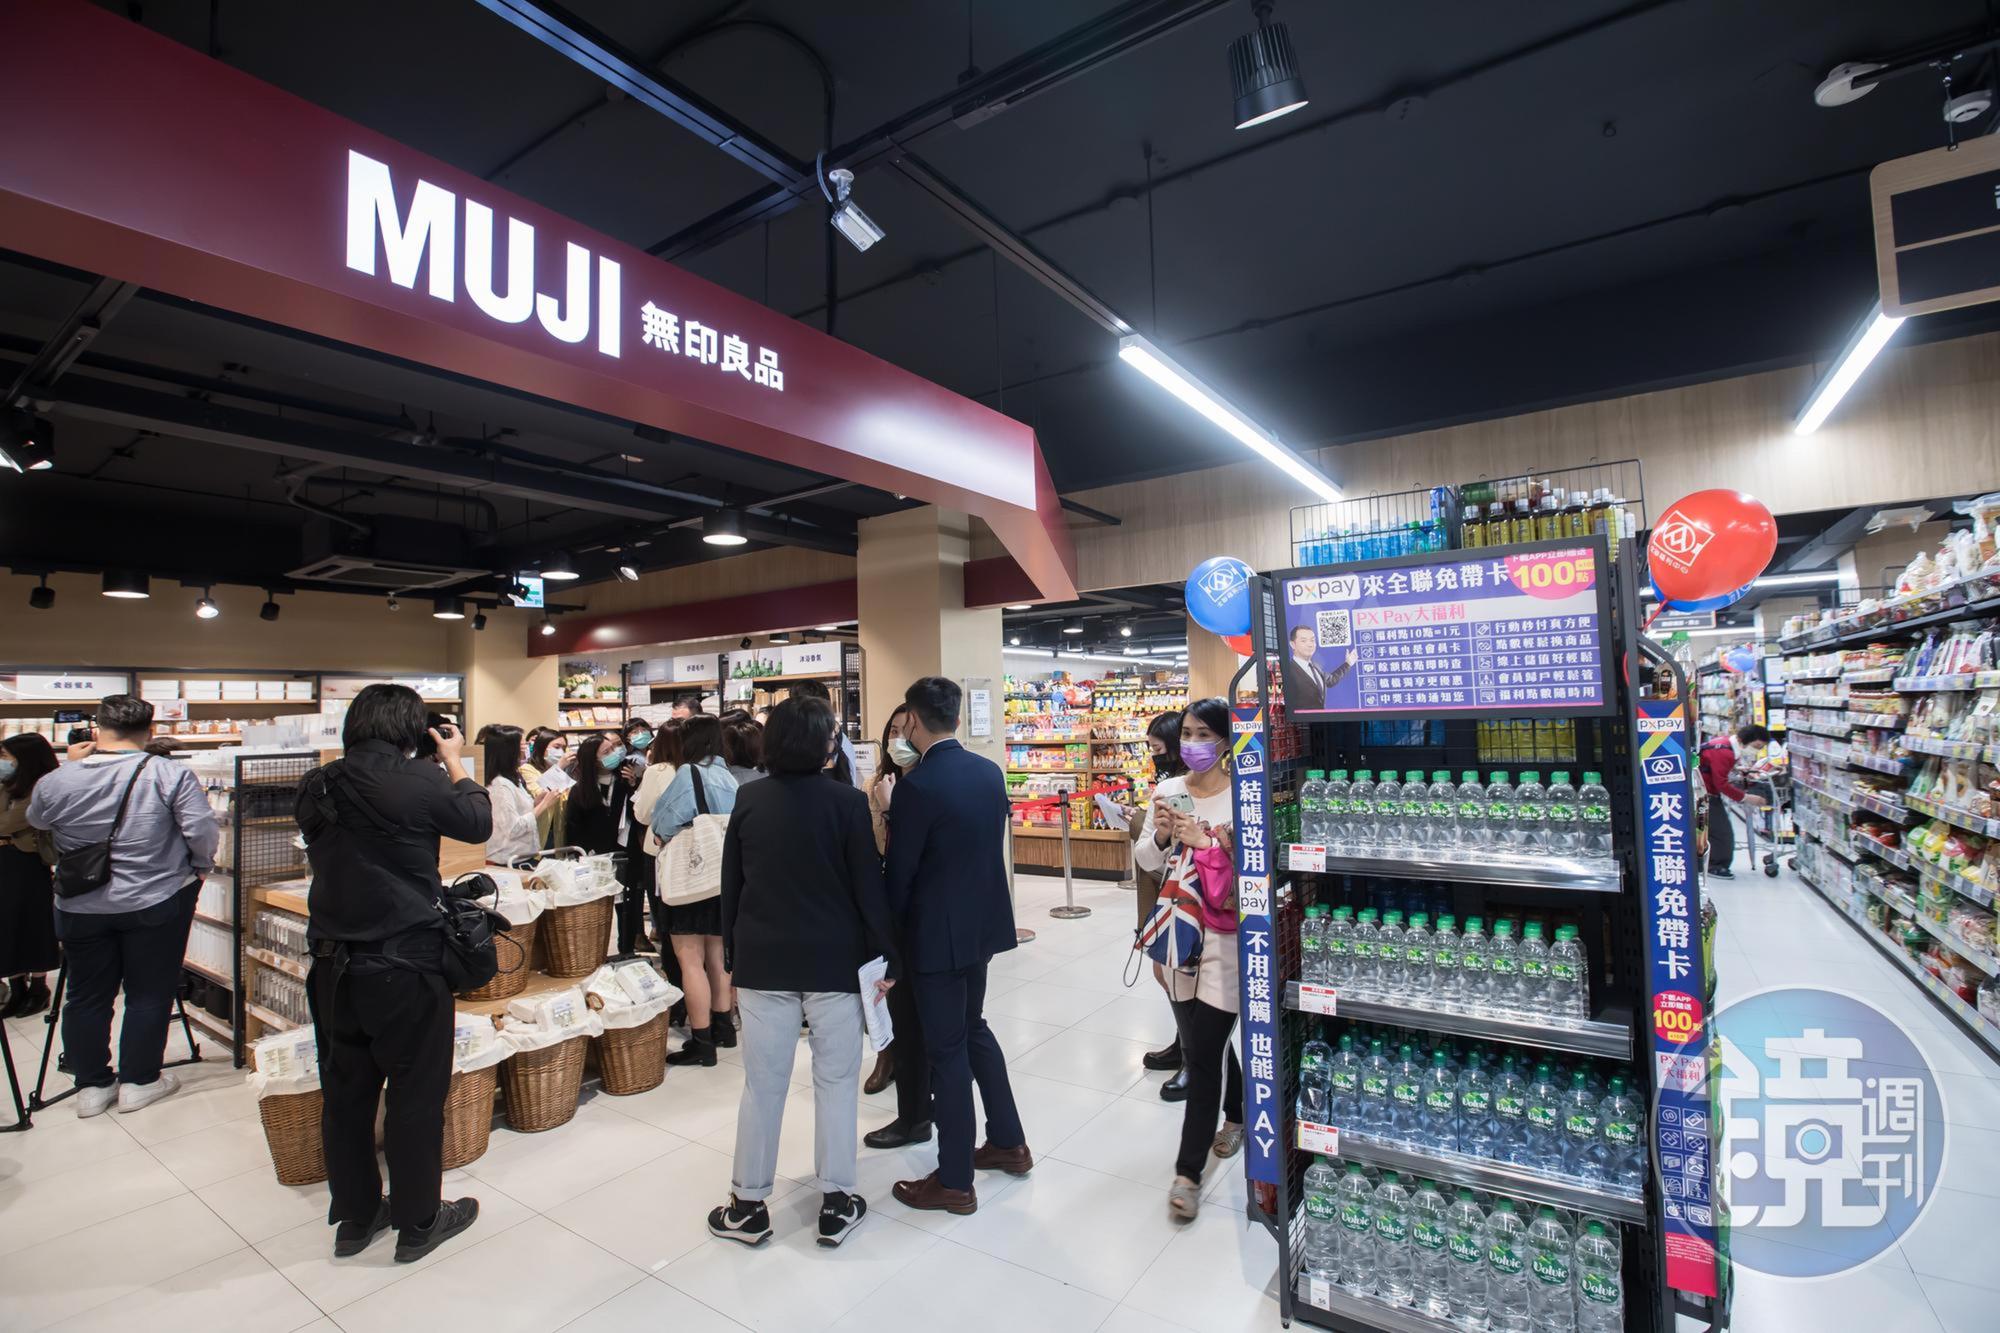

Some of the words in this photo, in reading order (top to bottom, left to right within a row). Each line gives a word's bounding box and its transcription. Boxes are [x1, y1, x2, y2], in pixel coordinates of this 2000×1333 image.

[346, 148, 621, 358] MUJI
[640, 300, 784, 392] 無印良品
[1363, 562, 1510, 597] 來全聯免帶卡
[1292, 578, 1355, 601] pxpay
[1357, 611, 1379, 625] PX
[1495, 616, 1591, 634] 行動秒付真方便
[1377, 642, 1461, 656] 手機也是會員卡
[1496, 634, 1592, 650] 點數輕鬆換商品
[1497, 652, 1592, 668] 線上儲值好輕鬆
[1498, 669, 1594, 684] 會員歸戶輕鬆管
[1500, 686, 1596, 701] 福利點數隨時用
[1234, 722, 1264, 732] pxpay
[1640, 719, 1682, 731] pxpay
[1239, 780, 1265, 873] 結帳改用
[1244, 880, 1263, 894] px
[1649, 792, 1692, 980] 來全聯免帶卡
[1240, 896, 1268, 914] pay
[1246, 930, 1271, 1024] 不用接觸
[1567, 1121, 1595, 1134] Volvic
[1606, 1129, 1636, 1142] Volvic
[1306, 1202, 1334, 1215] Volvic
[1342, 1212, 1369, 1226] Volvic
[1377, 1221, 1406, 1236] Volvic
[1414, 1230, 1444, 1244] Volvic
[1450, 1240, 1480, 1258] Volvic
[1488, 1251, 1521, 1268] Volvic
[1533, 1260, 1568, 1278] Volvic
[1582, 1278, 1618, 1296] Volvic
